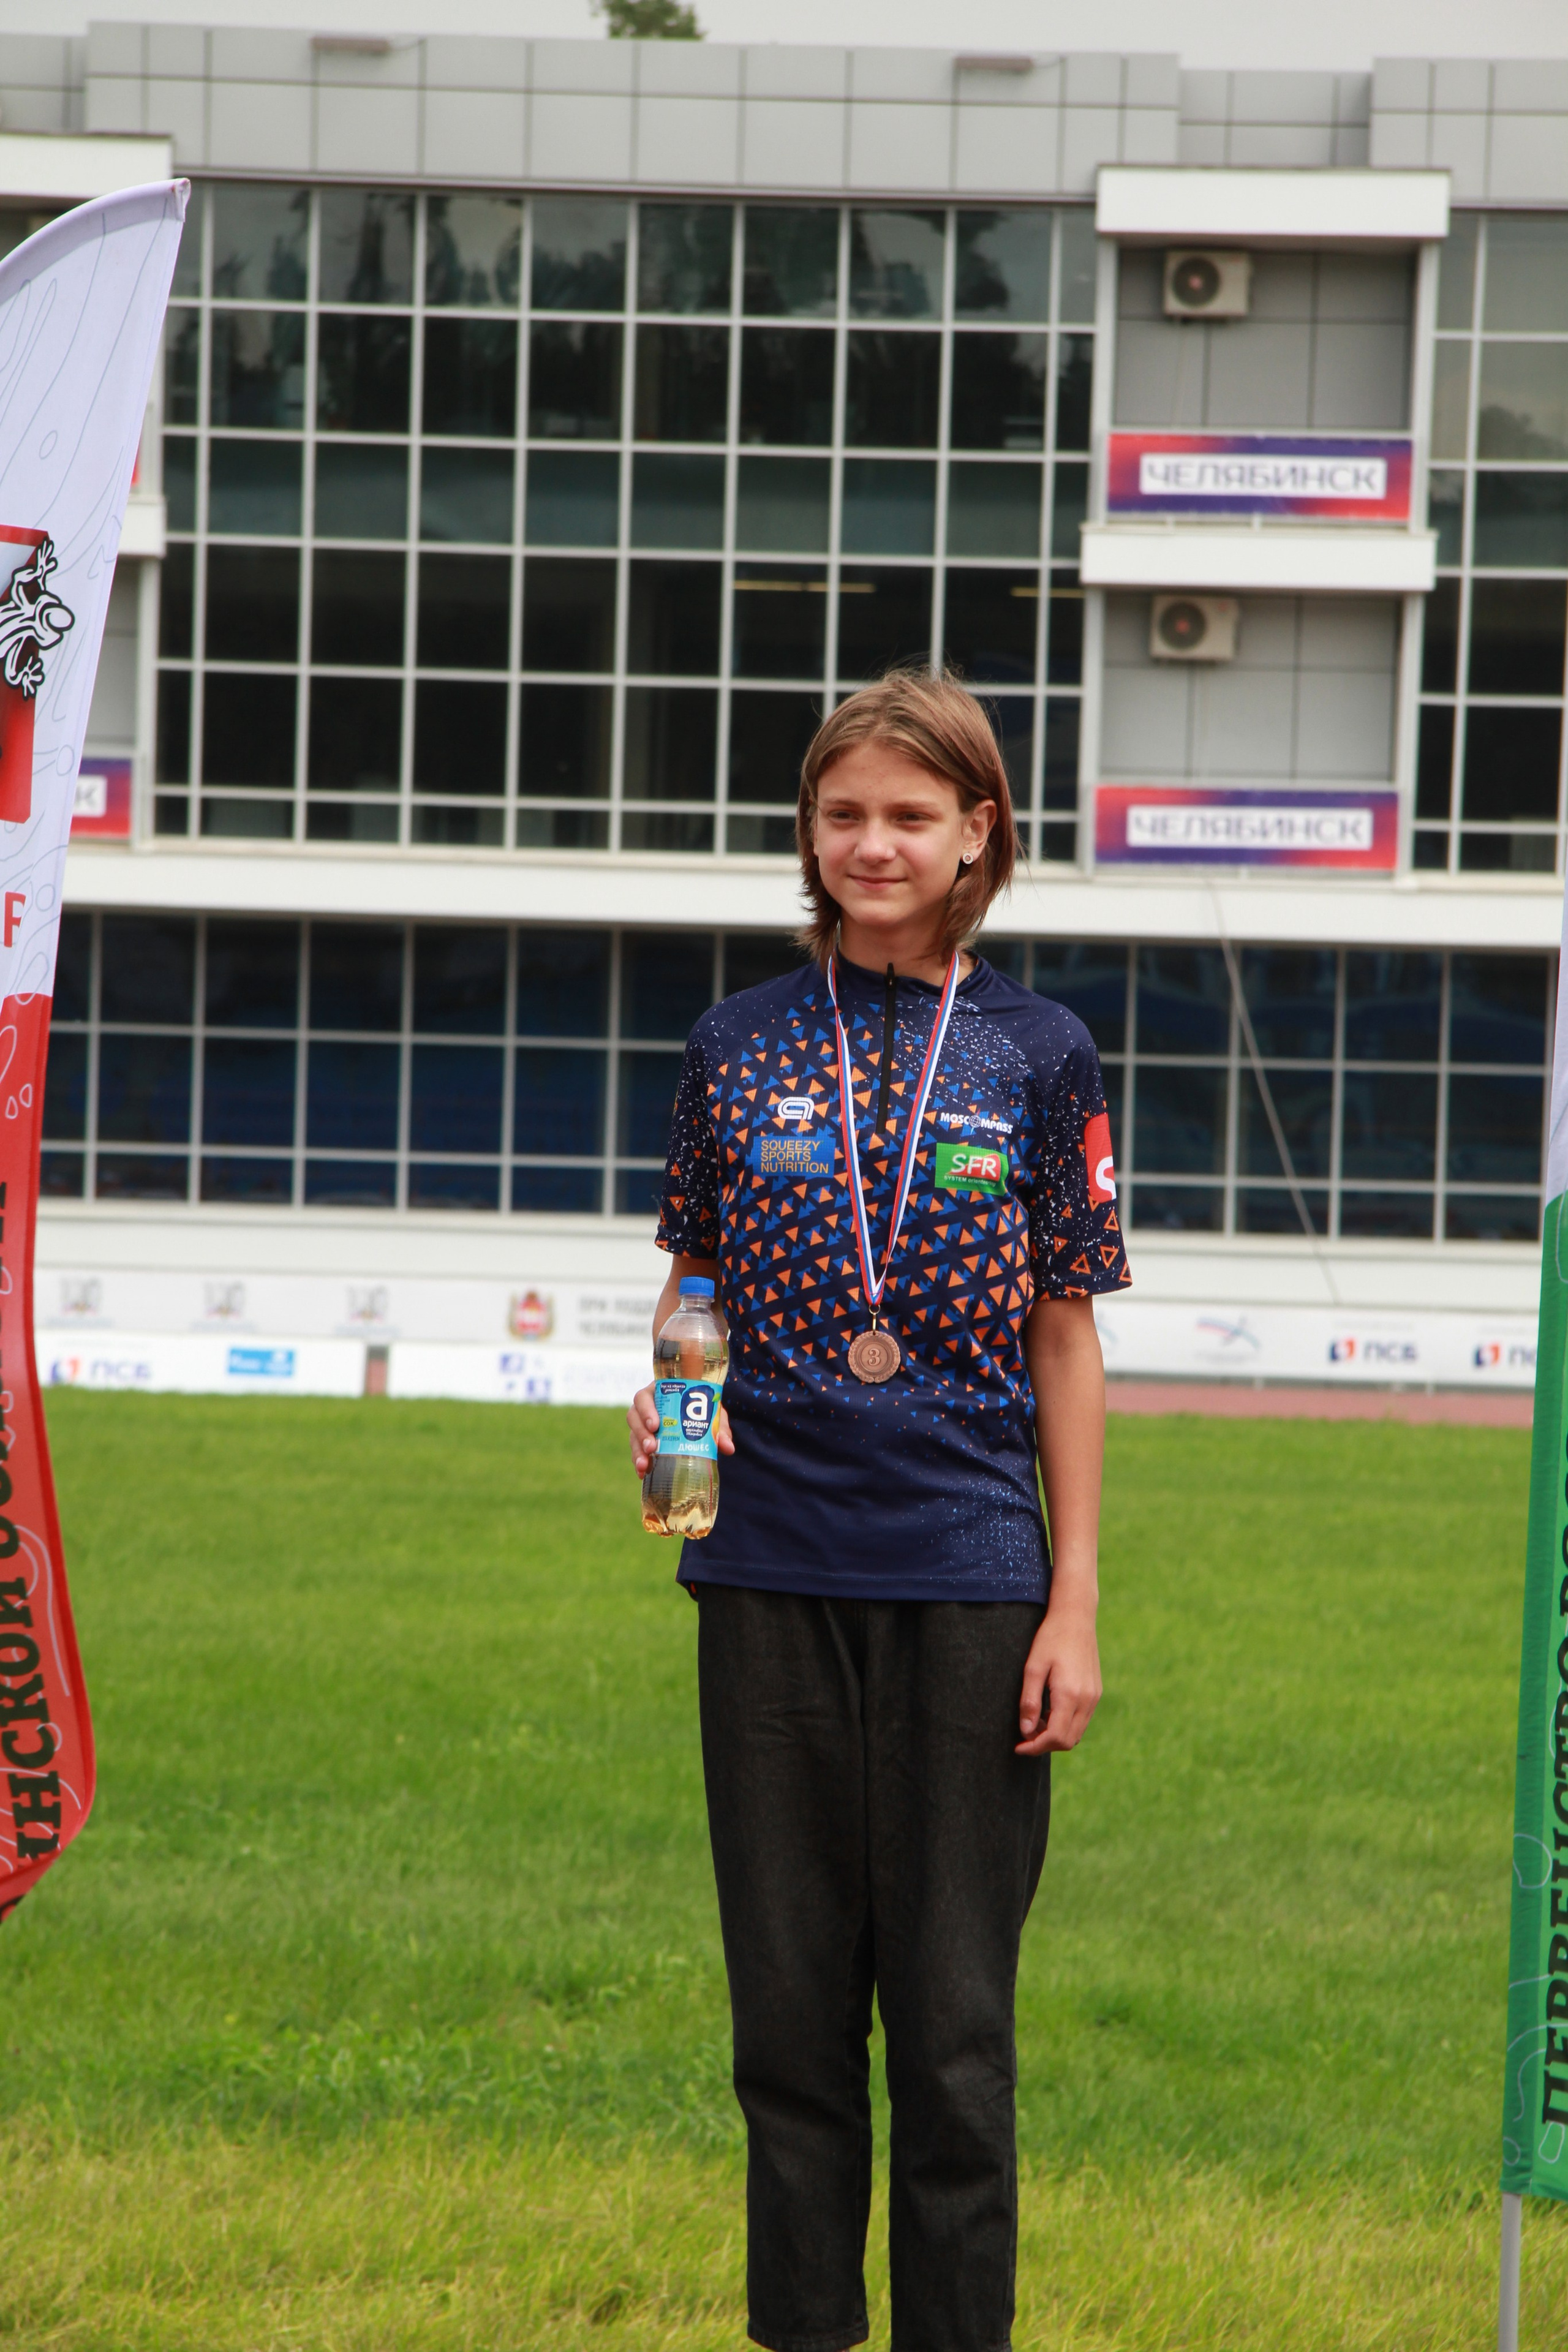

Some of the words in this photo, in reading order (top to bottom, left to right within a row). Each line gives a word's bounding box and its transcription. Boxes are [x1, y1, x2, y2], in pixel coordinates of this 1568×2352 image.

[1147, 461, 1378, 492] ЧЕЛЯБИНСК
[1133, 813, 1364, 843] ЧЕЛЯБИНСК
[761, 1140, 821, 1152] SQUEEZY
[761, 1150, 812, 1161] SPORTS
[761, 1161, 829, 1174] NUTRITION
[950, 1153, 997, 1177] SFR
[867, 1348, 881, 1366] 3
[682, 1420, 709, 1429] ариант
[678, 1443, 710, 1452] ДЮШЕС
